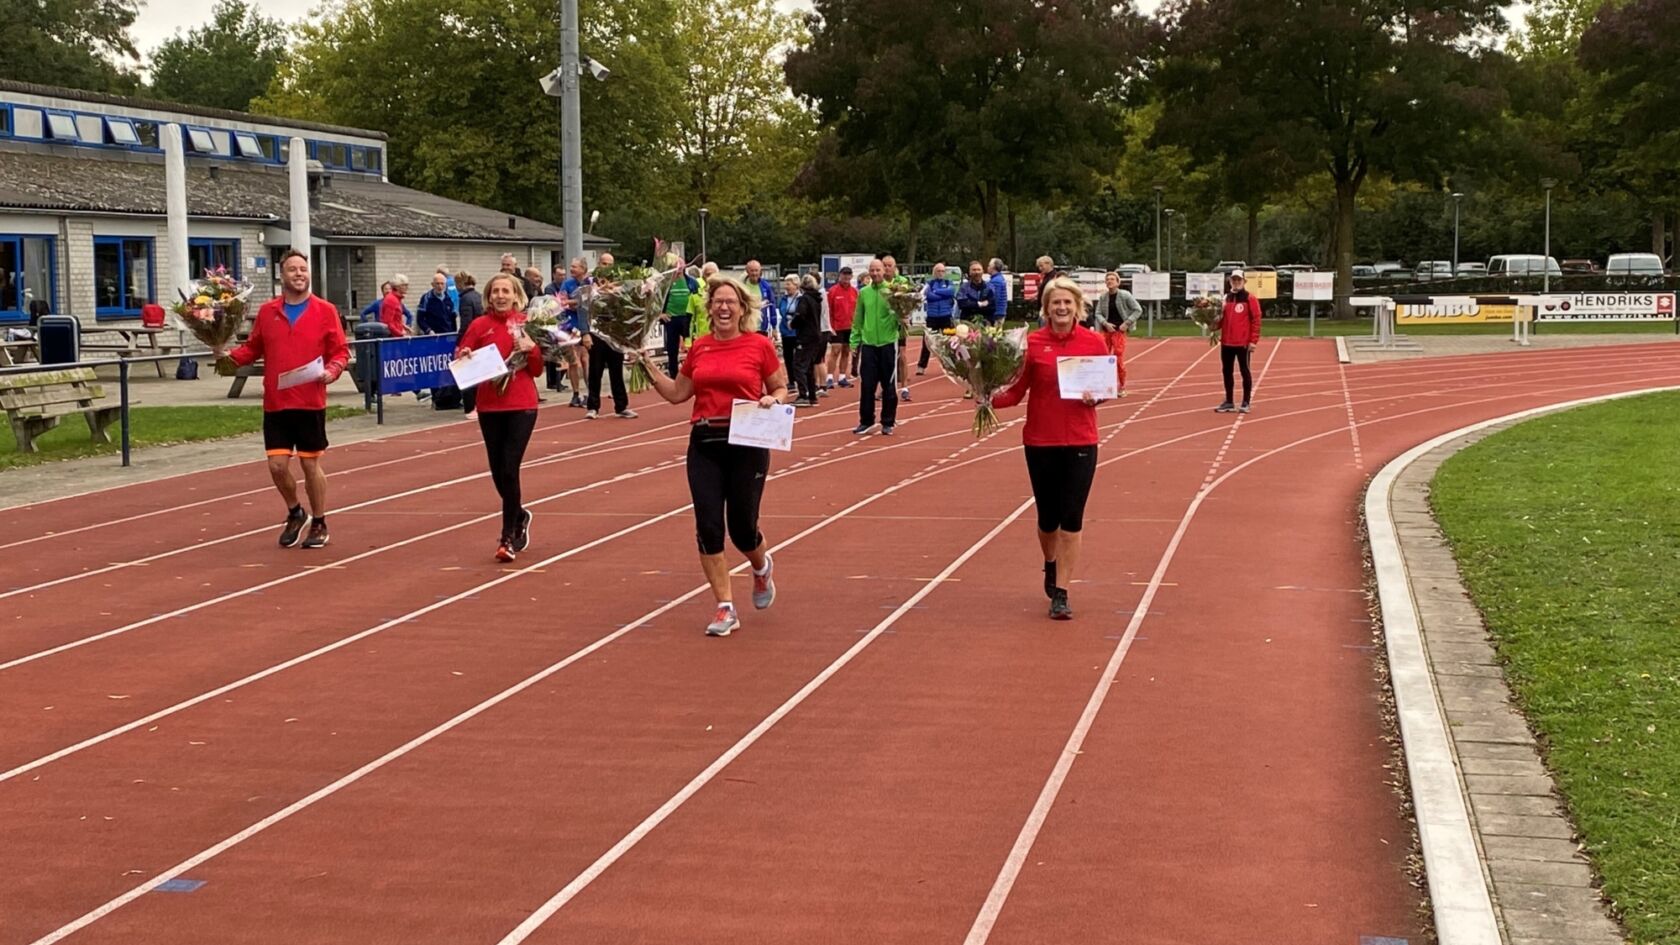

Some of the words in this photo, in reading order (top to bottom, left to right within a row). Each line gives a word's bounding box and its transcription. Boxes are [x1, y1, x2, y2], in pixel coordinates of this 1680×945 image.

[1574, 295, 1653, 306] HENDRIKS
[1402, 304, 1480, 318] JUMBO
[383, 357, 418, 378] KROESE
[419, 353, 452, 373] WEVERS
